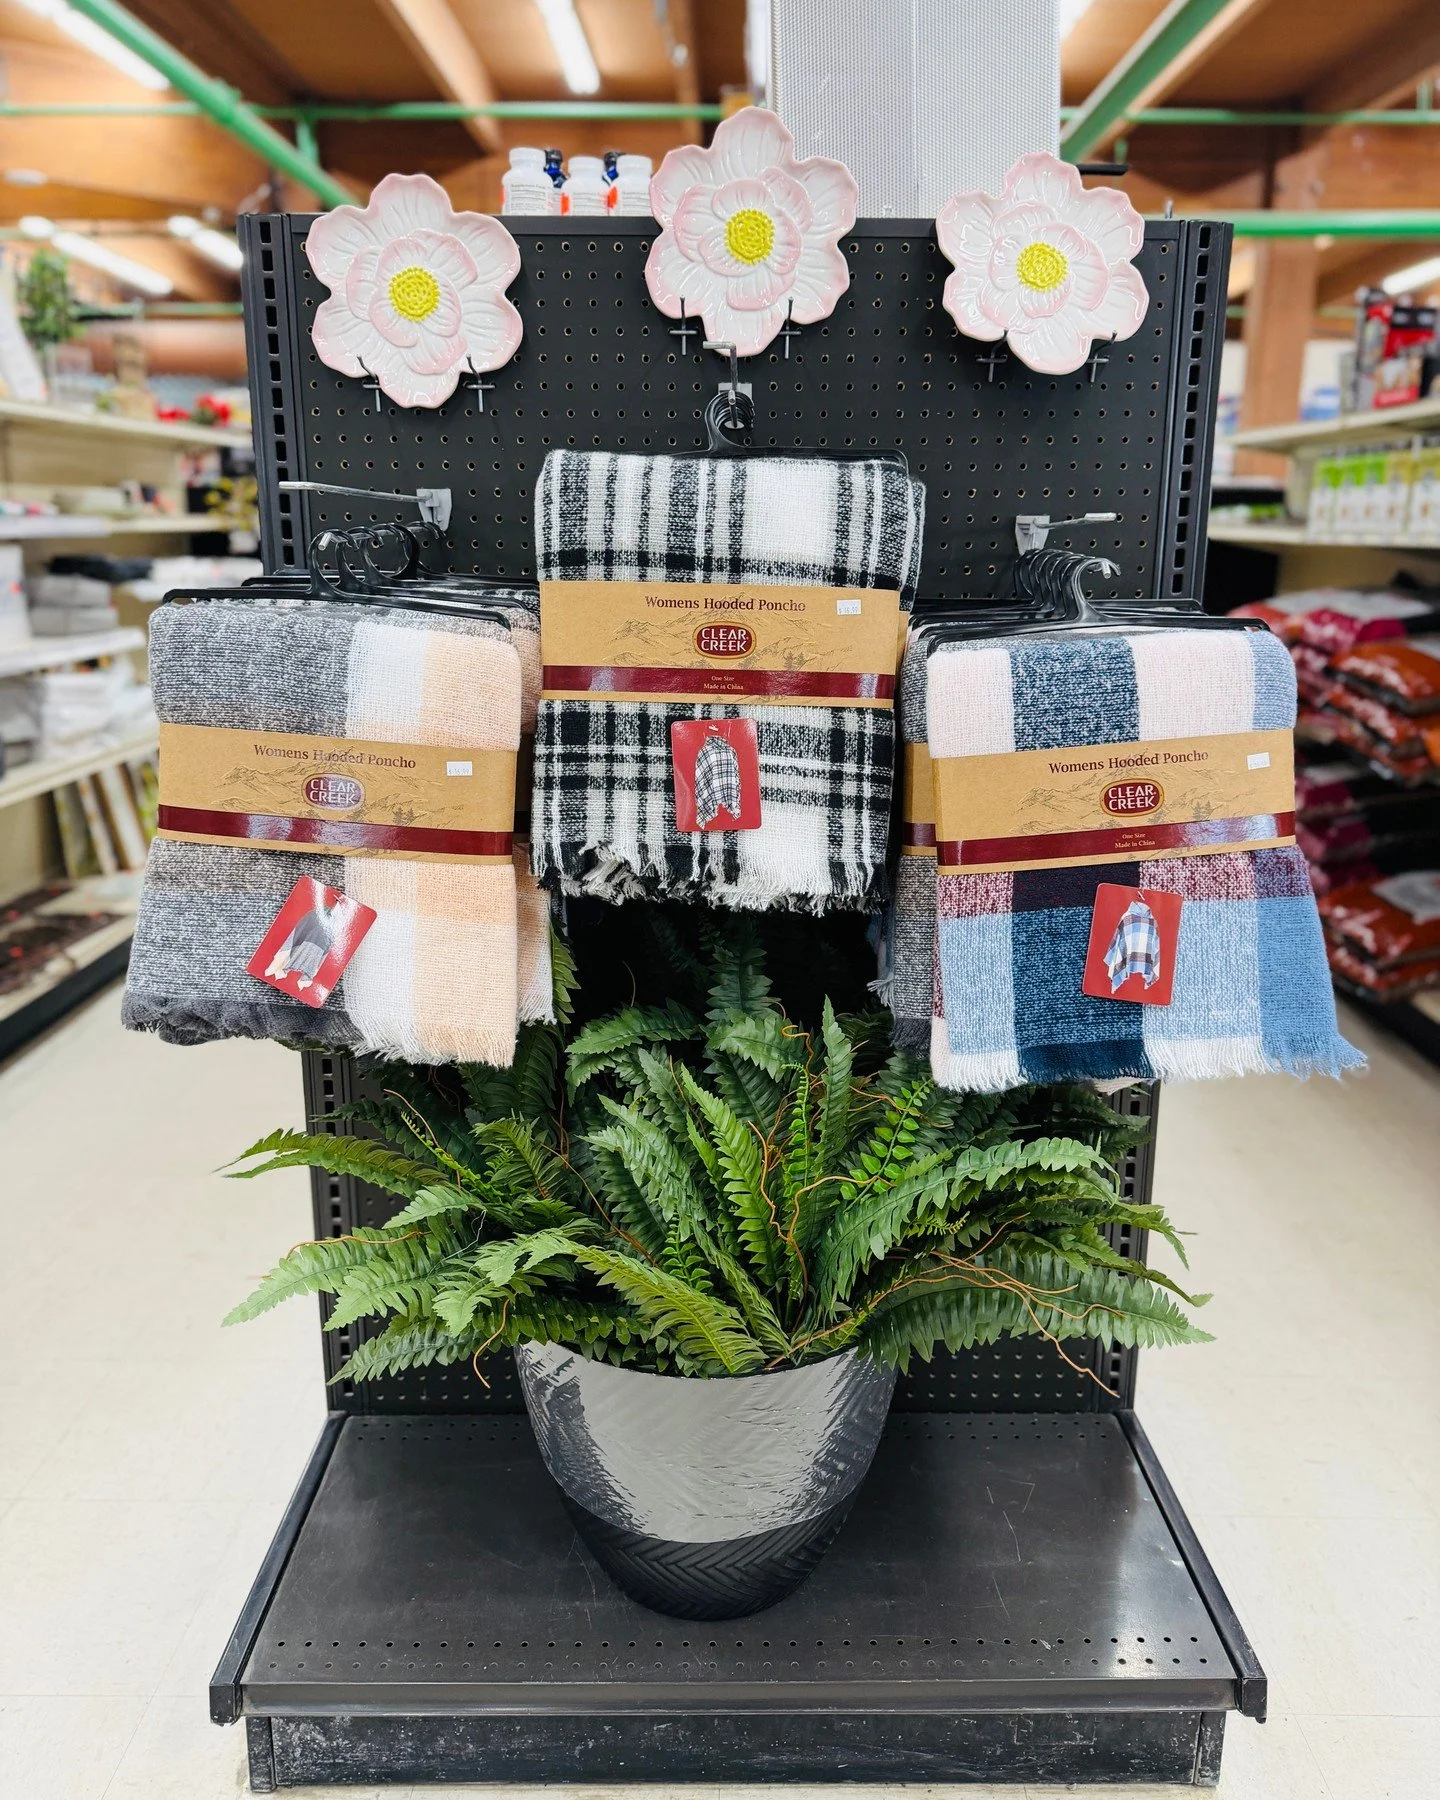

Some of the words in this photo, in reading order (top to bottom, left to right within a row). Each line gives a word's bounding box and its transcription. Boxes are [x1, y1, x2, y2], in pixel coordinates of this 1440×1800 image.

[645, 596, 700, 609] Womens
[704, 597, 754, 610] Hooded
[759, 599, 806, 611] Poncho
[701, 628, 747, 640] CLEAR
[701, 640, 747, 652] CREEK
[254, 744, 309, 760] Womens
[313, 749, 364, 764] Hooded
[368, 754, 417, 769] Poncho
[1049, 761, 1104, 774] Womens
[1108, 753, 1159, 769] Hooded
[1163, 750, 1209, 764] Poncho
[310, 779, 356, 793] CLEAR
[1108, 785, 1155, 799] CLEAR
[309, 791, 356, 805] CREEK
[1108, 796, 1155, 811] CREEK
